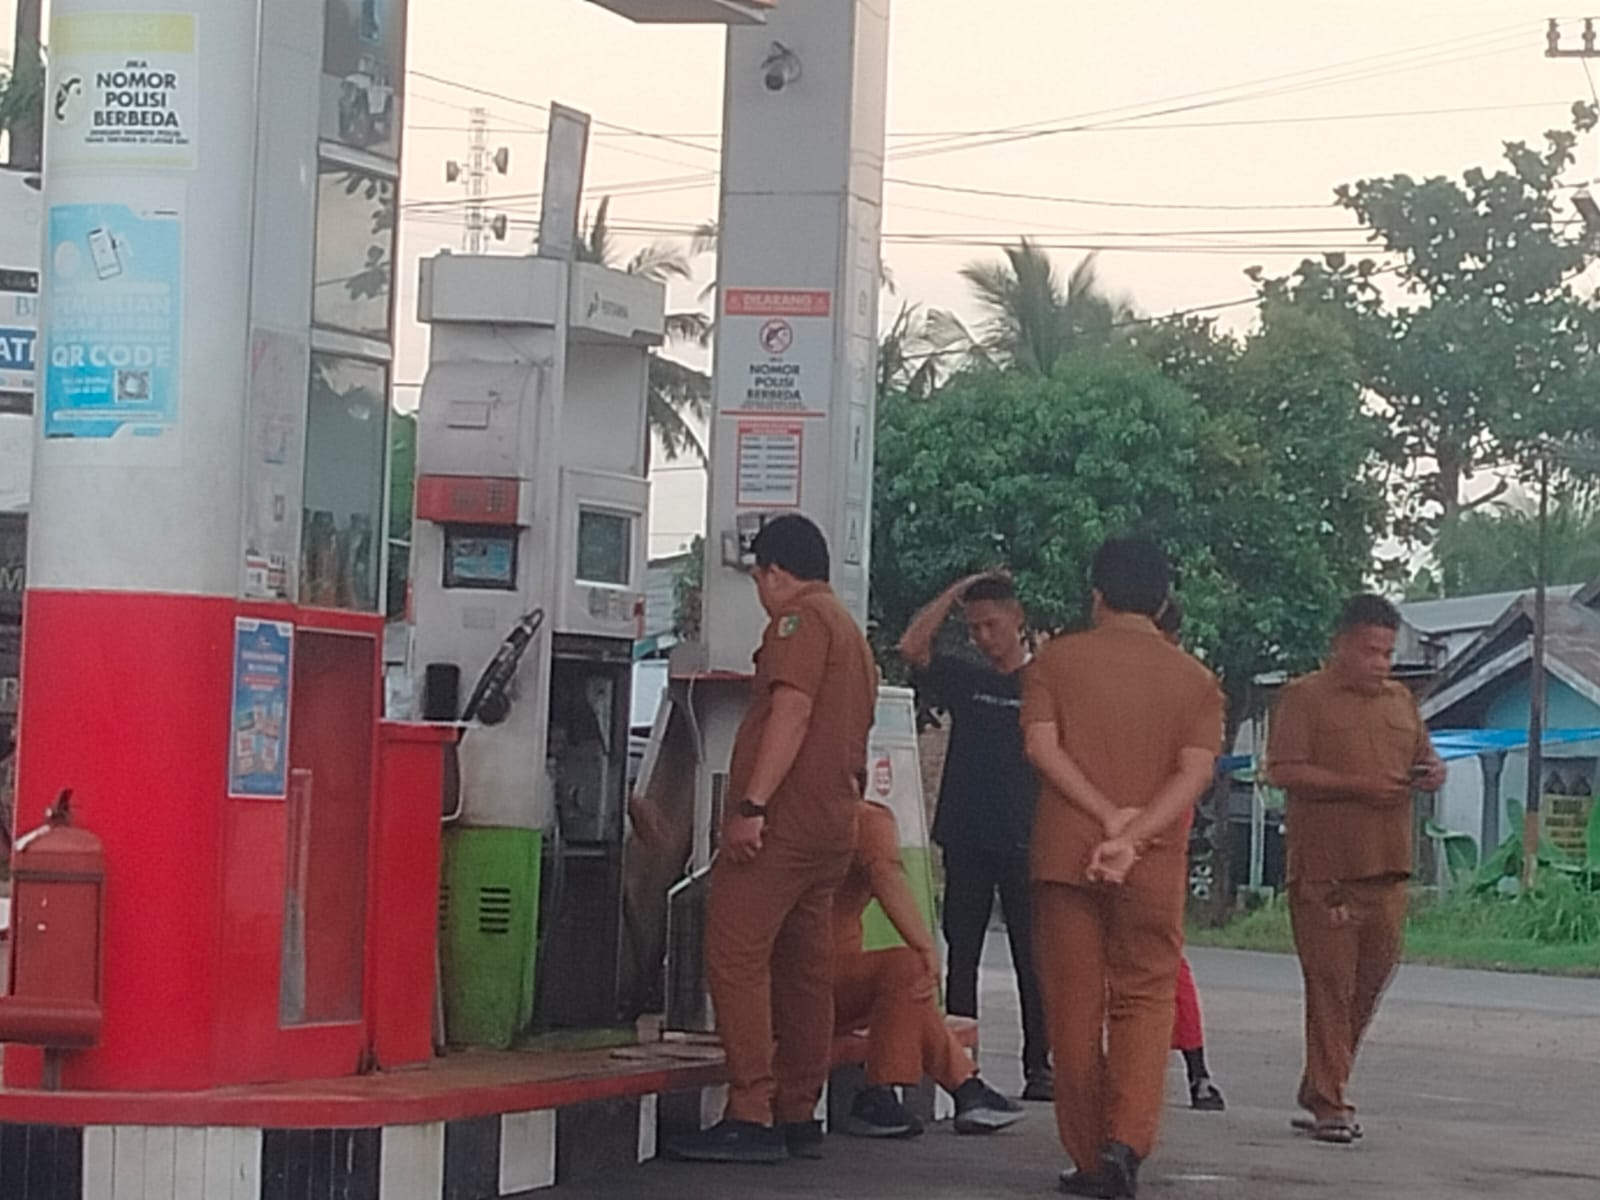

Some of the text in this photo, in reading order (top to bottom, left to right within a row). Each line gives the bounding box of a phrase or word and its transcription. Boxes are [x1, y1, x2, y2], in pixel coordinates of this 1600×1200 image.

[96, 71, 176, 90] NOMOR
[105, 91, 166, 108] POLISI
[93, 110, 179, 128] BERBEDA
[51, 345, 170, 368] QR CODE
[749, 364, 800, 375] NOMOR
[755, 377, 795, 388] POLISI
[746, 389, 802, 401] BERBEDA
